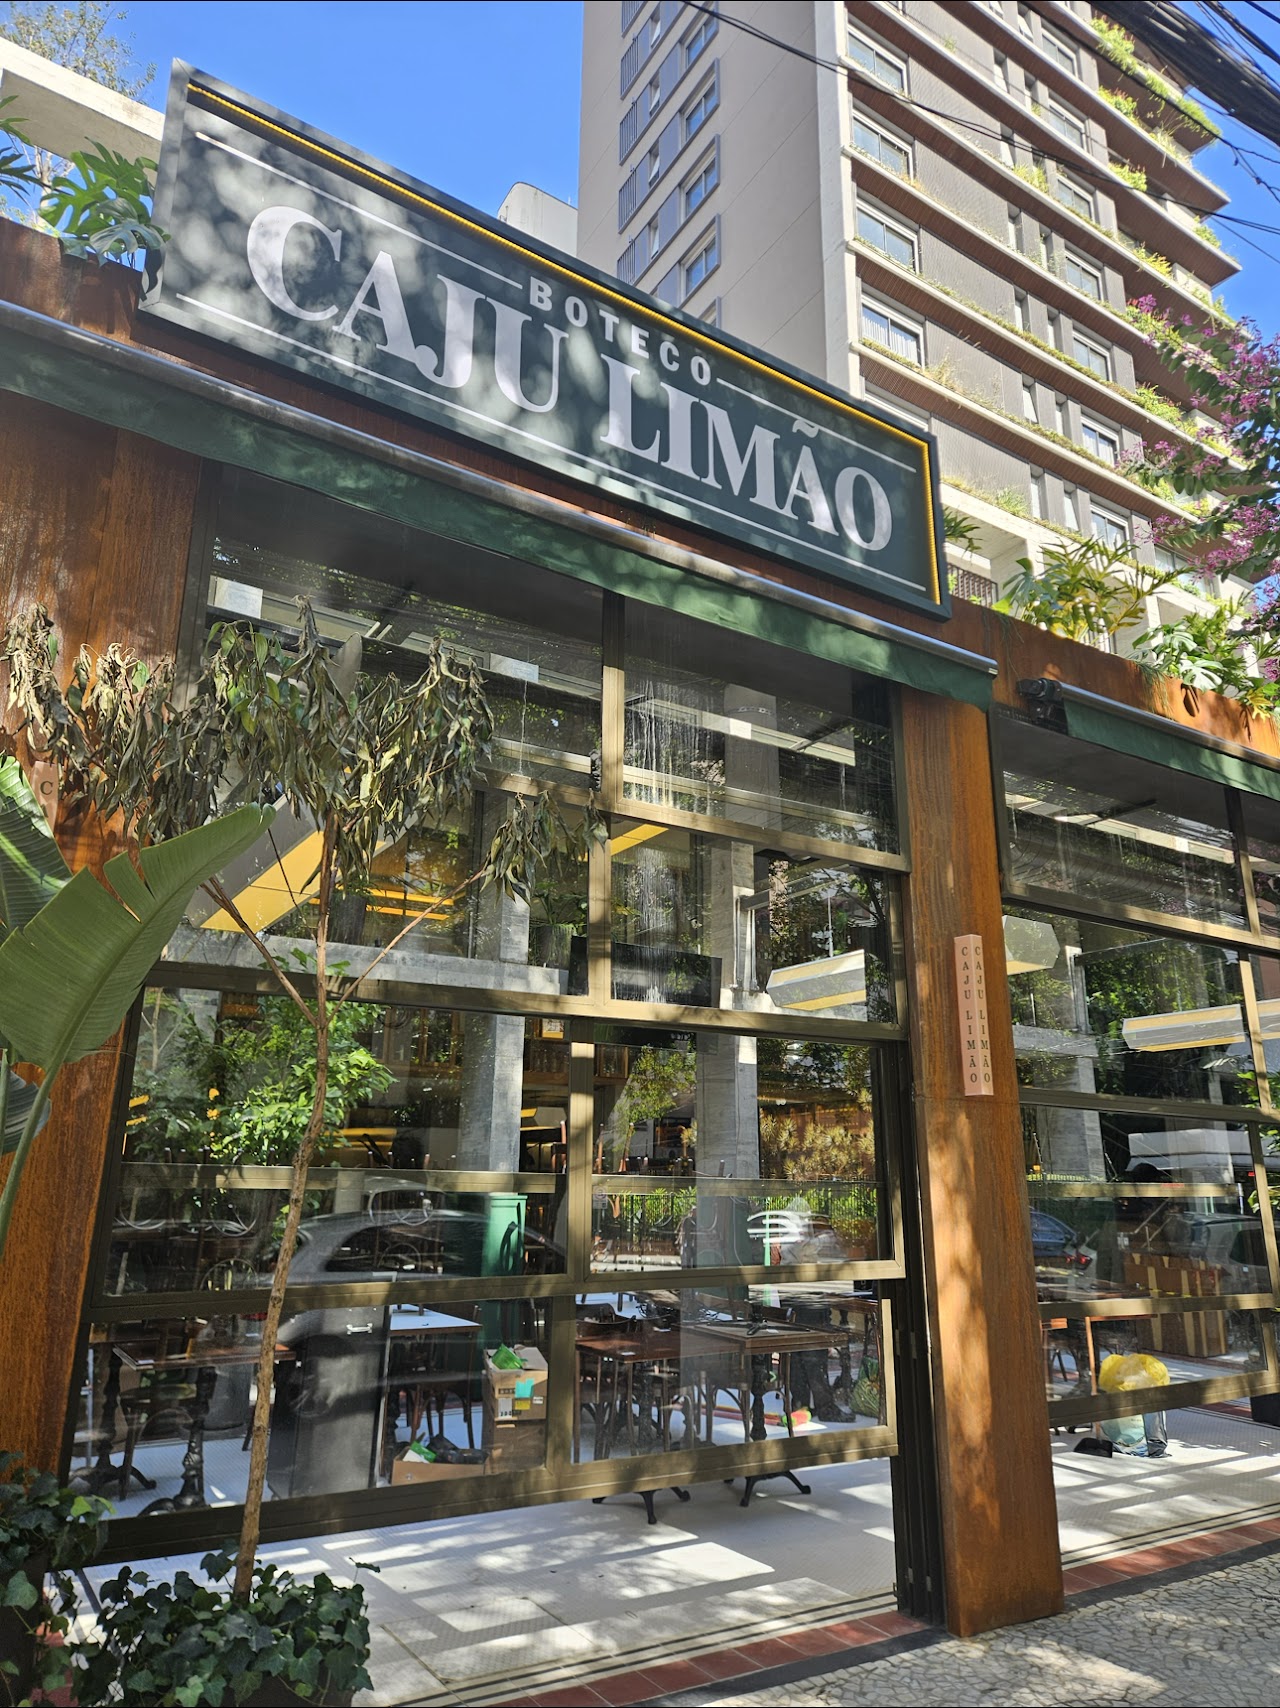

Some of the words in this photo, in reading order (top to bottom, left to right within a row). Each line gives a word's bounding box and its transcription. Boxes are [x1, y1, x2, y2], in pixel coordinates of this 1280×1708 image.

[247, 206, 569, 413] CAJU
[601, 354, 892, 551] LIMÃO
[530, 276, 711, 385] BOTECO
[961, 946, 971, 999] CAJU
[966, 1010, 977, 1083] LIMÃO
[974, 946, 984, 999] CAJU
[980, 1010, 990, 1083] LIMÃO
